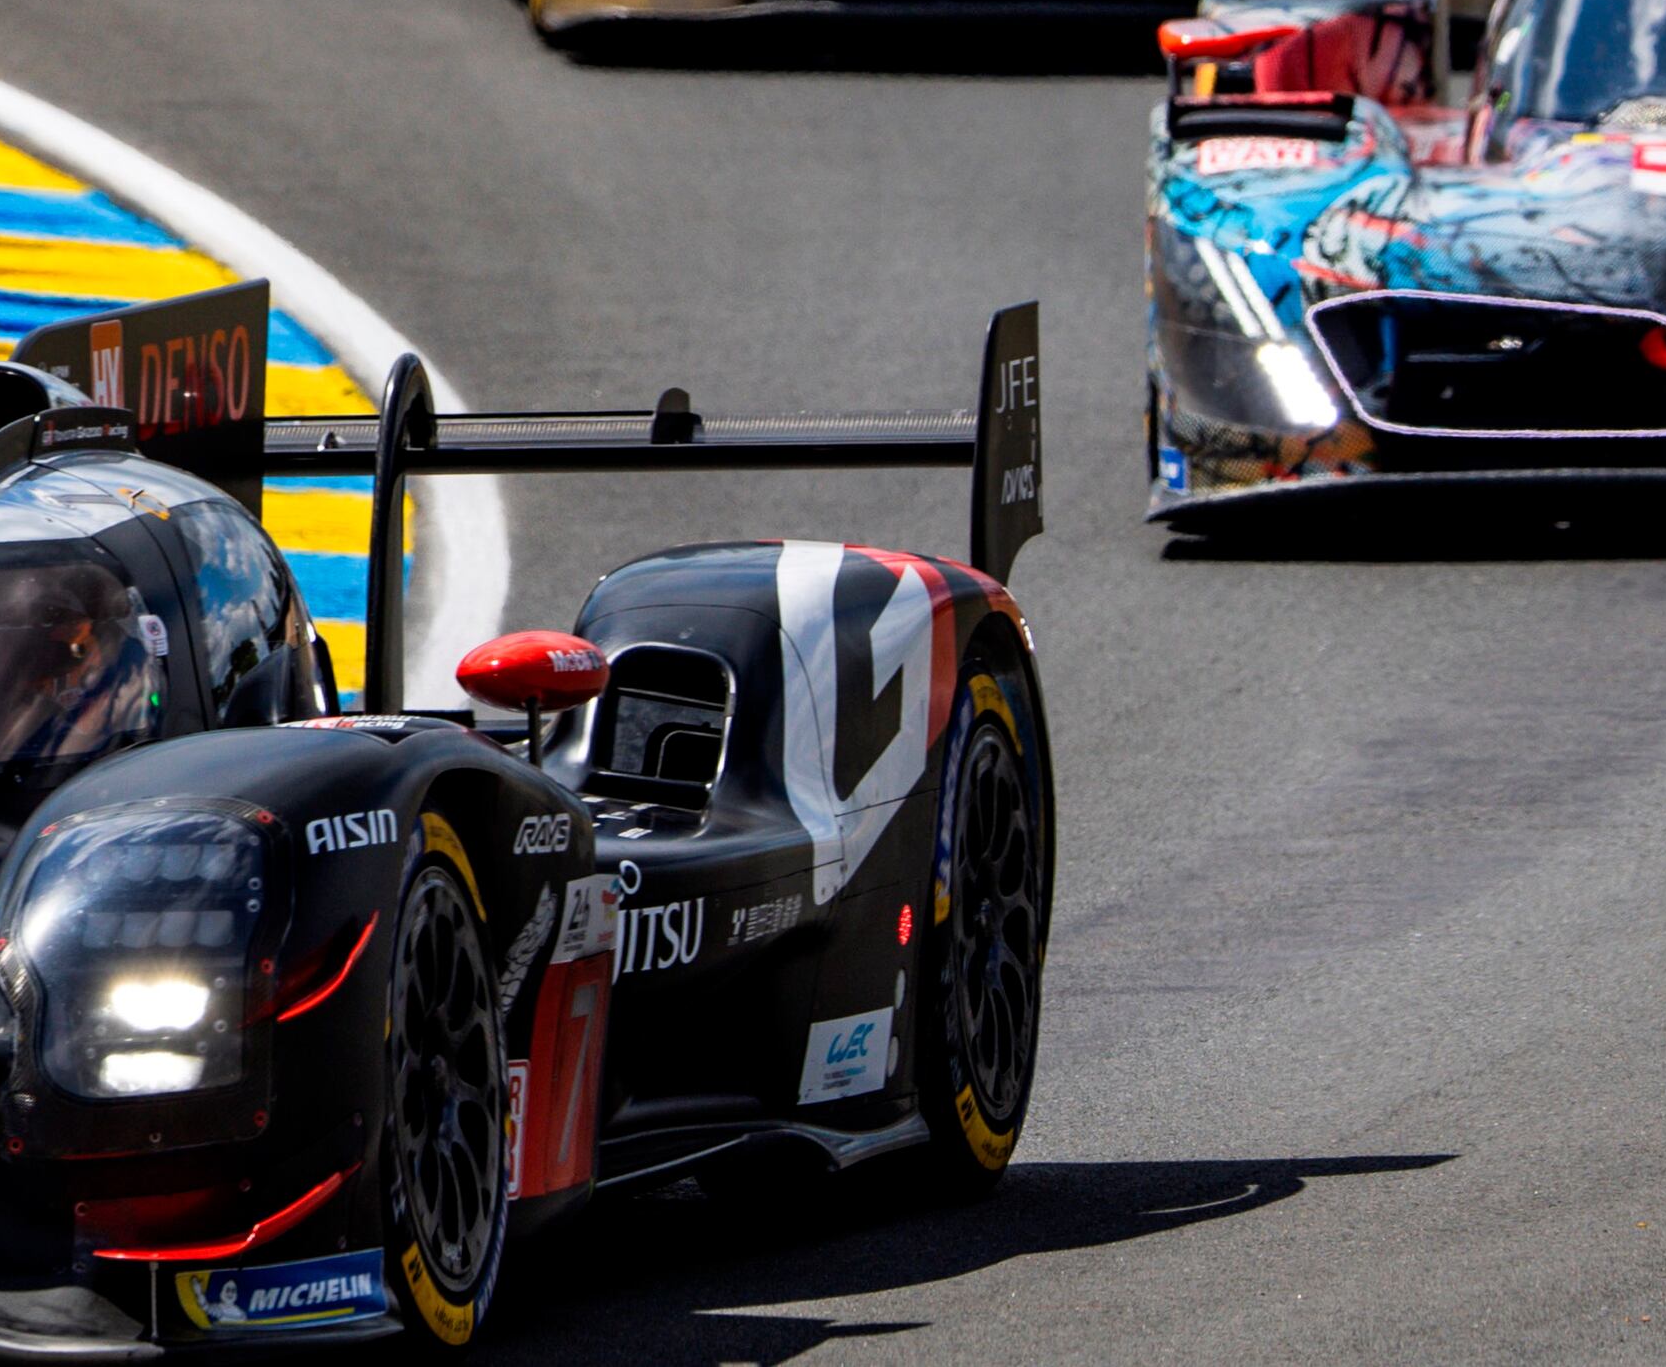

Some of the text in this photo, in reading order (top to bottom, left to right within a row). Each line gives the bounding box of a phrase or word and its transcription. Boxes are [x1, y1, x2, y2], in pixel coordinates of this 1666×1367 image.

[92, 324, 251, 441] HY DENSO
[995, 355, 1037, 415] JFE
[545, 649, 591, 672] Mobil
[306, 808, 399, 855] AISIN
[513, 813, 572, 855] RAYS
[557, 979, 597, 1164] 7
[249, 1272, 373, 1313] MICHELIN
